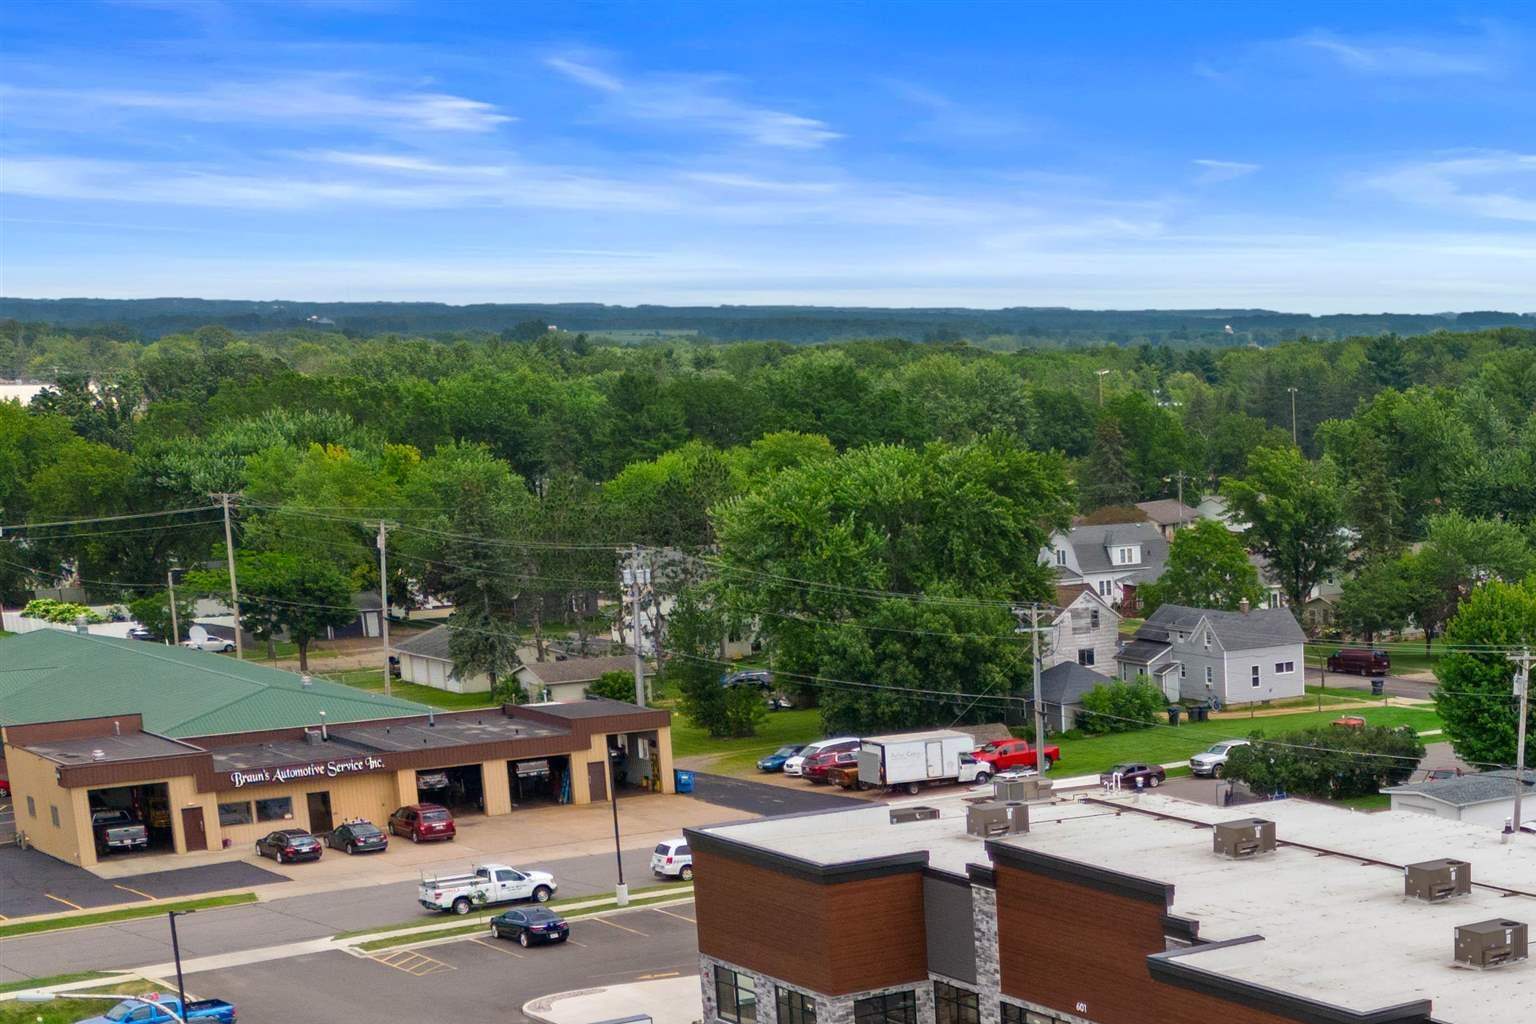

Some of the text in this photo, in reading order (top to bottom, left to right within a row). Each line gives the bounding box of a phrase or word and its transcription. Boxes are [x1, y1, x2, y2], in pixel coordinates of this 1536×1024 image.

[231, 756, 385, 788] Braun's Automotive Service Inc.
[1076, 1001, 1087, 1013] 601
